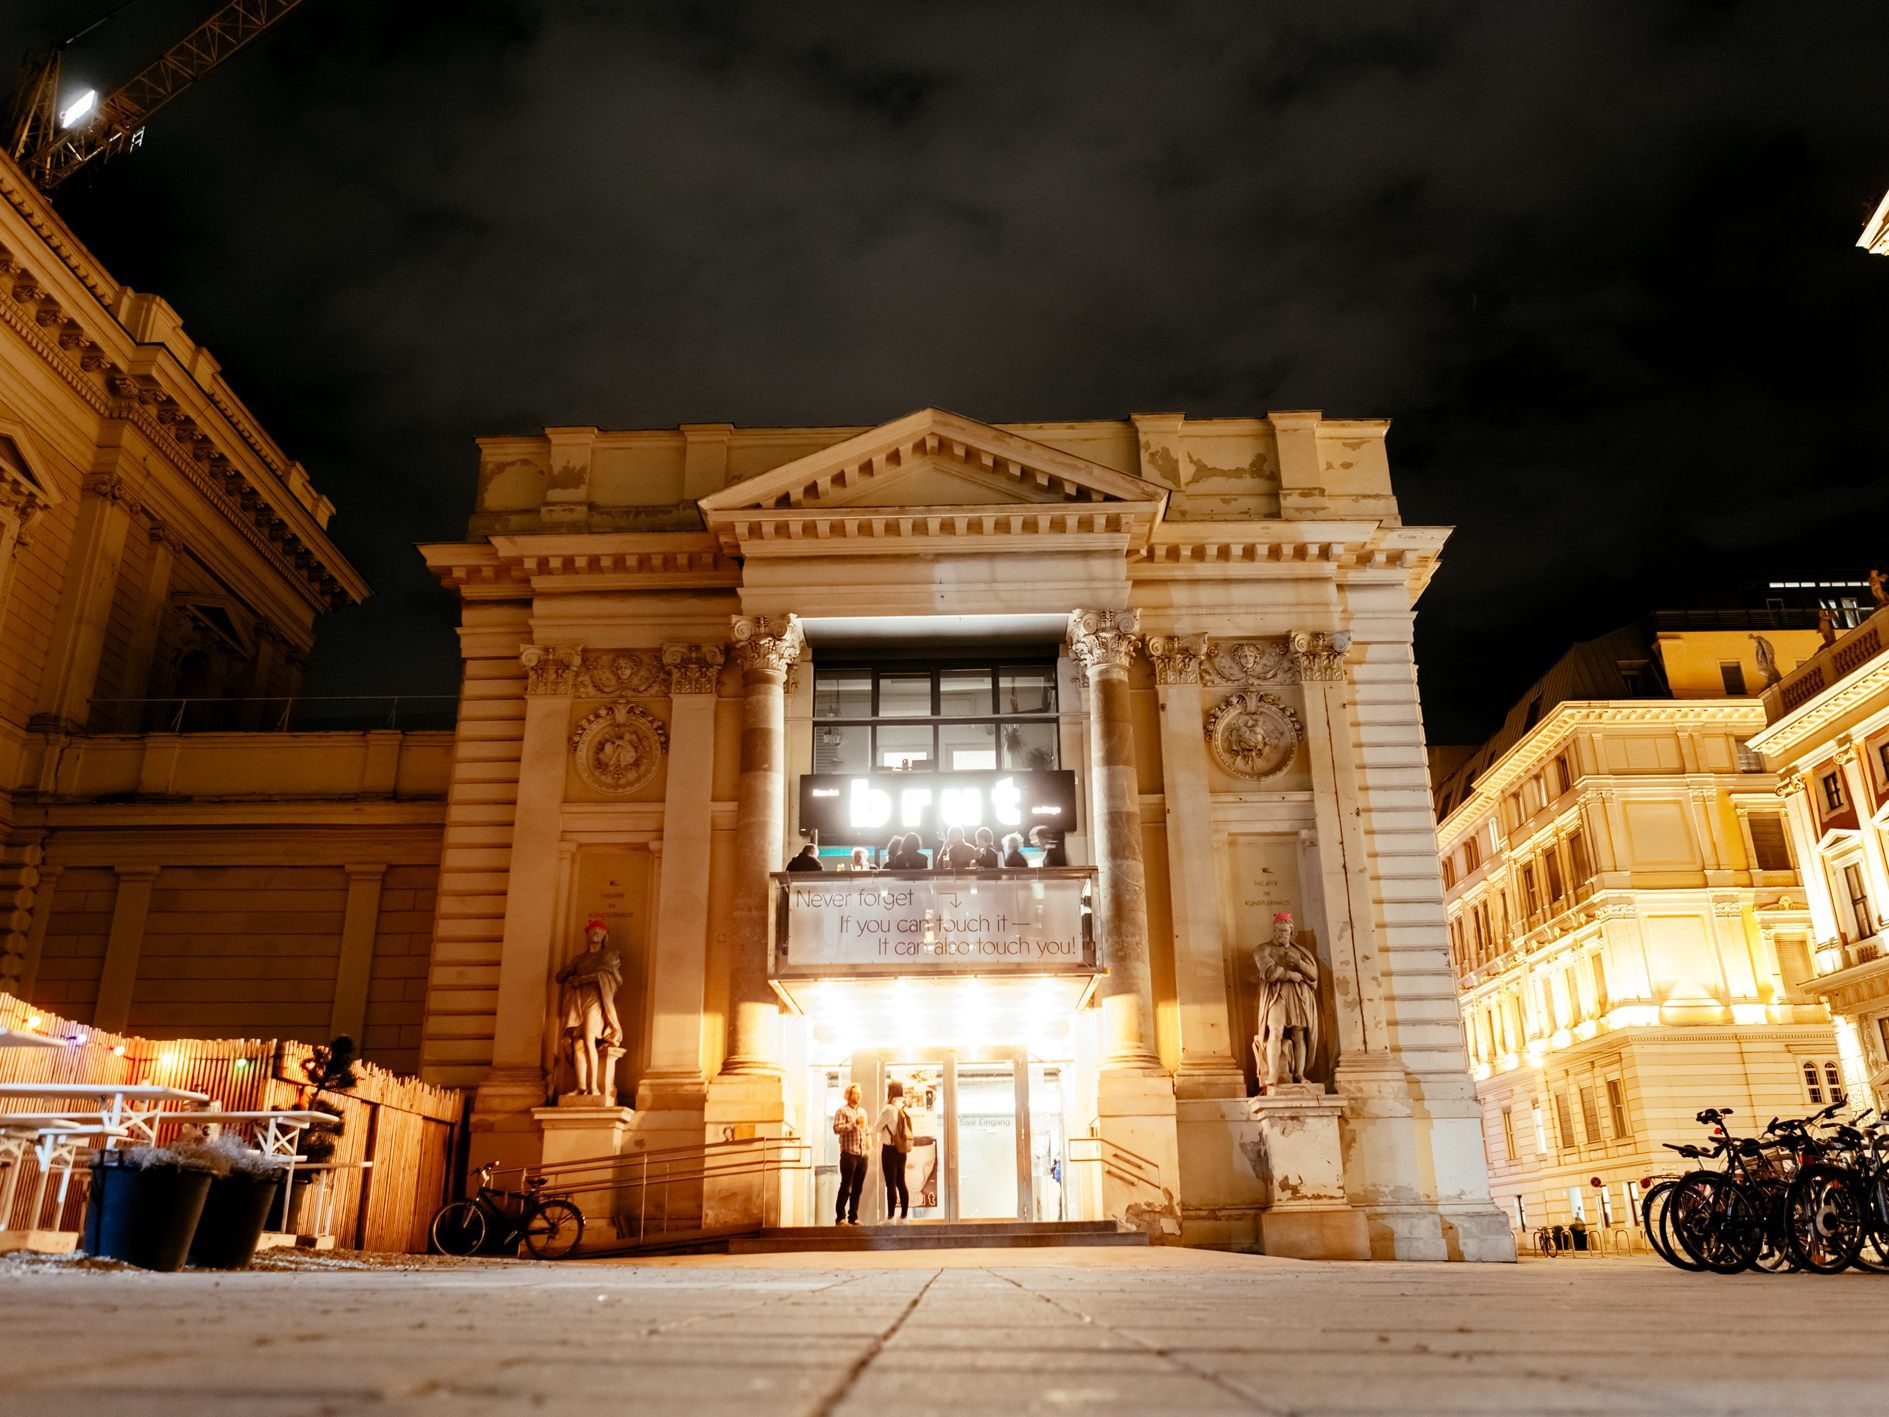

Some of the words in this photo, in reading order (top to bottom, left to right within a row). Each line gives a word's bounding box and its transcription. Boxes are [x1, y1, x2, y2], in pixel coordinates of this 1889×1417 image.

[850, 776, 1021, 828] brut
[796, 888, 851, 908] Never
[858, 888, 914, 911] forget
[840, 914, 851, 933] If
[856, 919, 890, 938] you
[897, 919, 930, 933] can
[936, 914, 990, 933] touch
[997, 914, 1008, 933] it
[878, 937, 889, 956] It
[976, 936, 1030, 956] touch
[1036, 936, 1076, 959] you!
[958, 1118, 977, 1127] Saal
[978, 1118, 1011, 1128] Eingang
